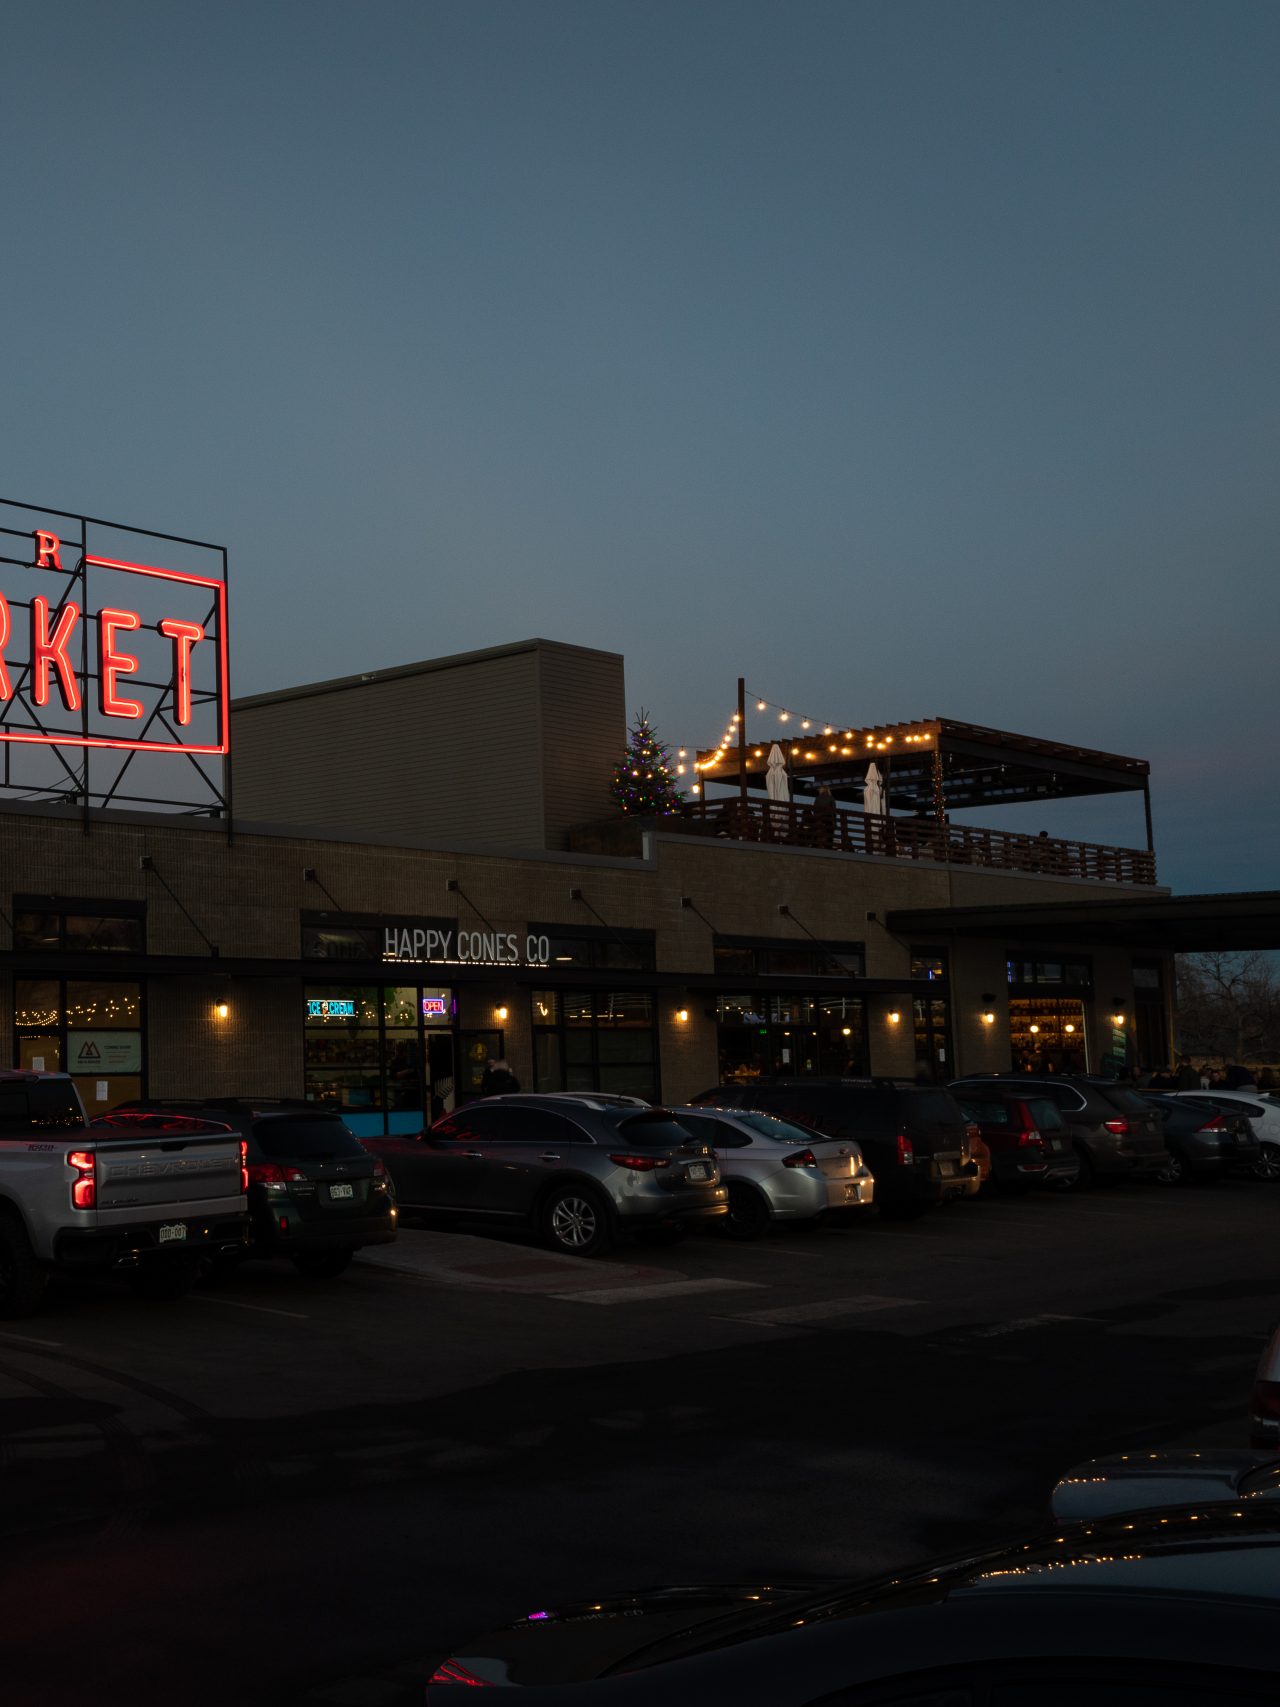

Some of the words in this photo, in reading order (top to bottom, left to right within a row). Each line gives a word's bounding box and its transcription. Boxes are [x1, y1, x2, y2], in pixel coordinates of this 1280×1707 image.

[384, 927, 452, 959] HAPPY
[457, 931, 519, 962] CONES
[526, 934, 550, 963] CO
[309, 1001, 321, 1015] ICE
[329, 1001, 354, 1016] CREAM
[424, 1001, 442, 1012] OPEN
